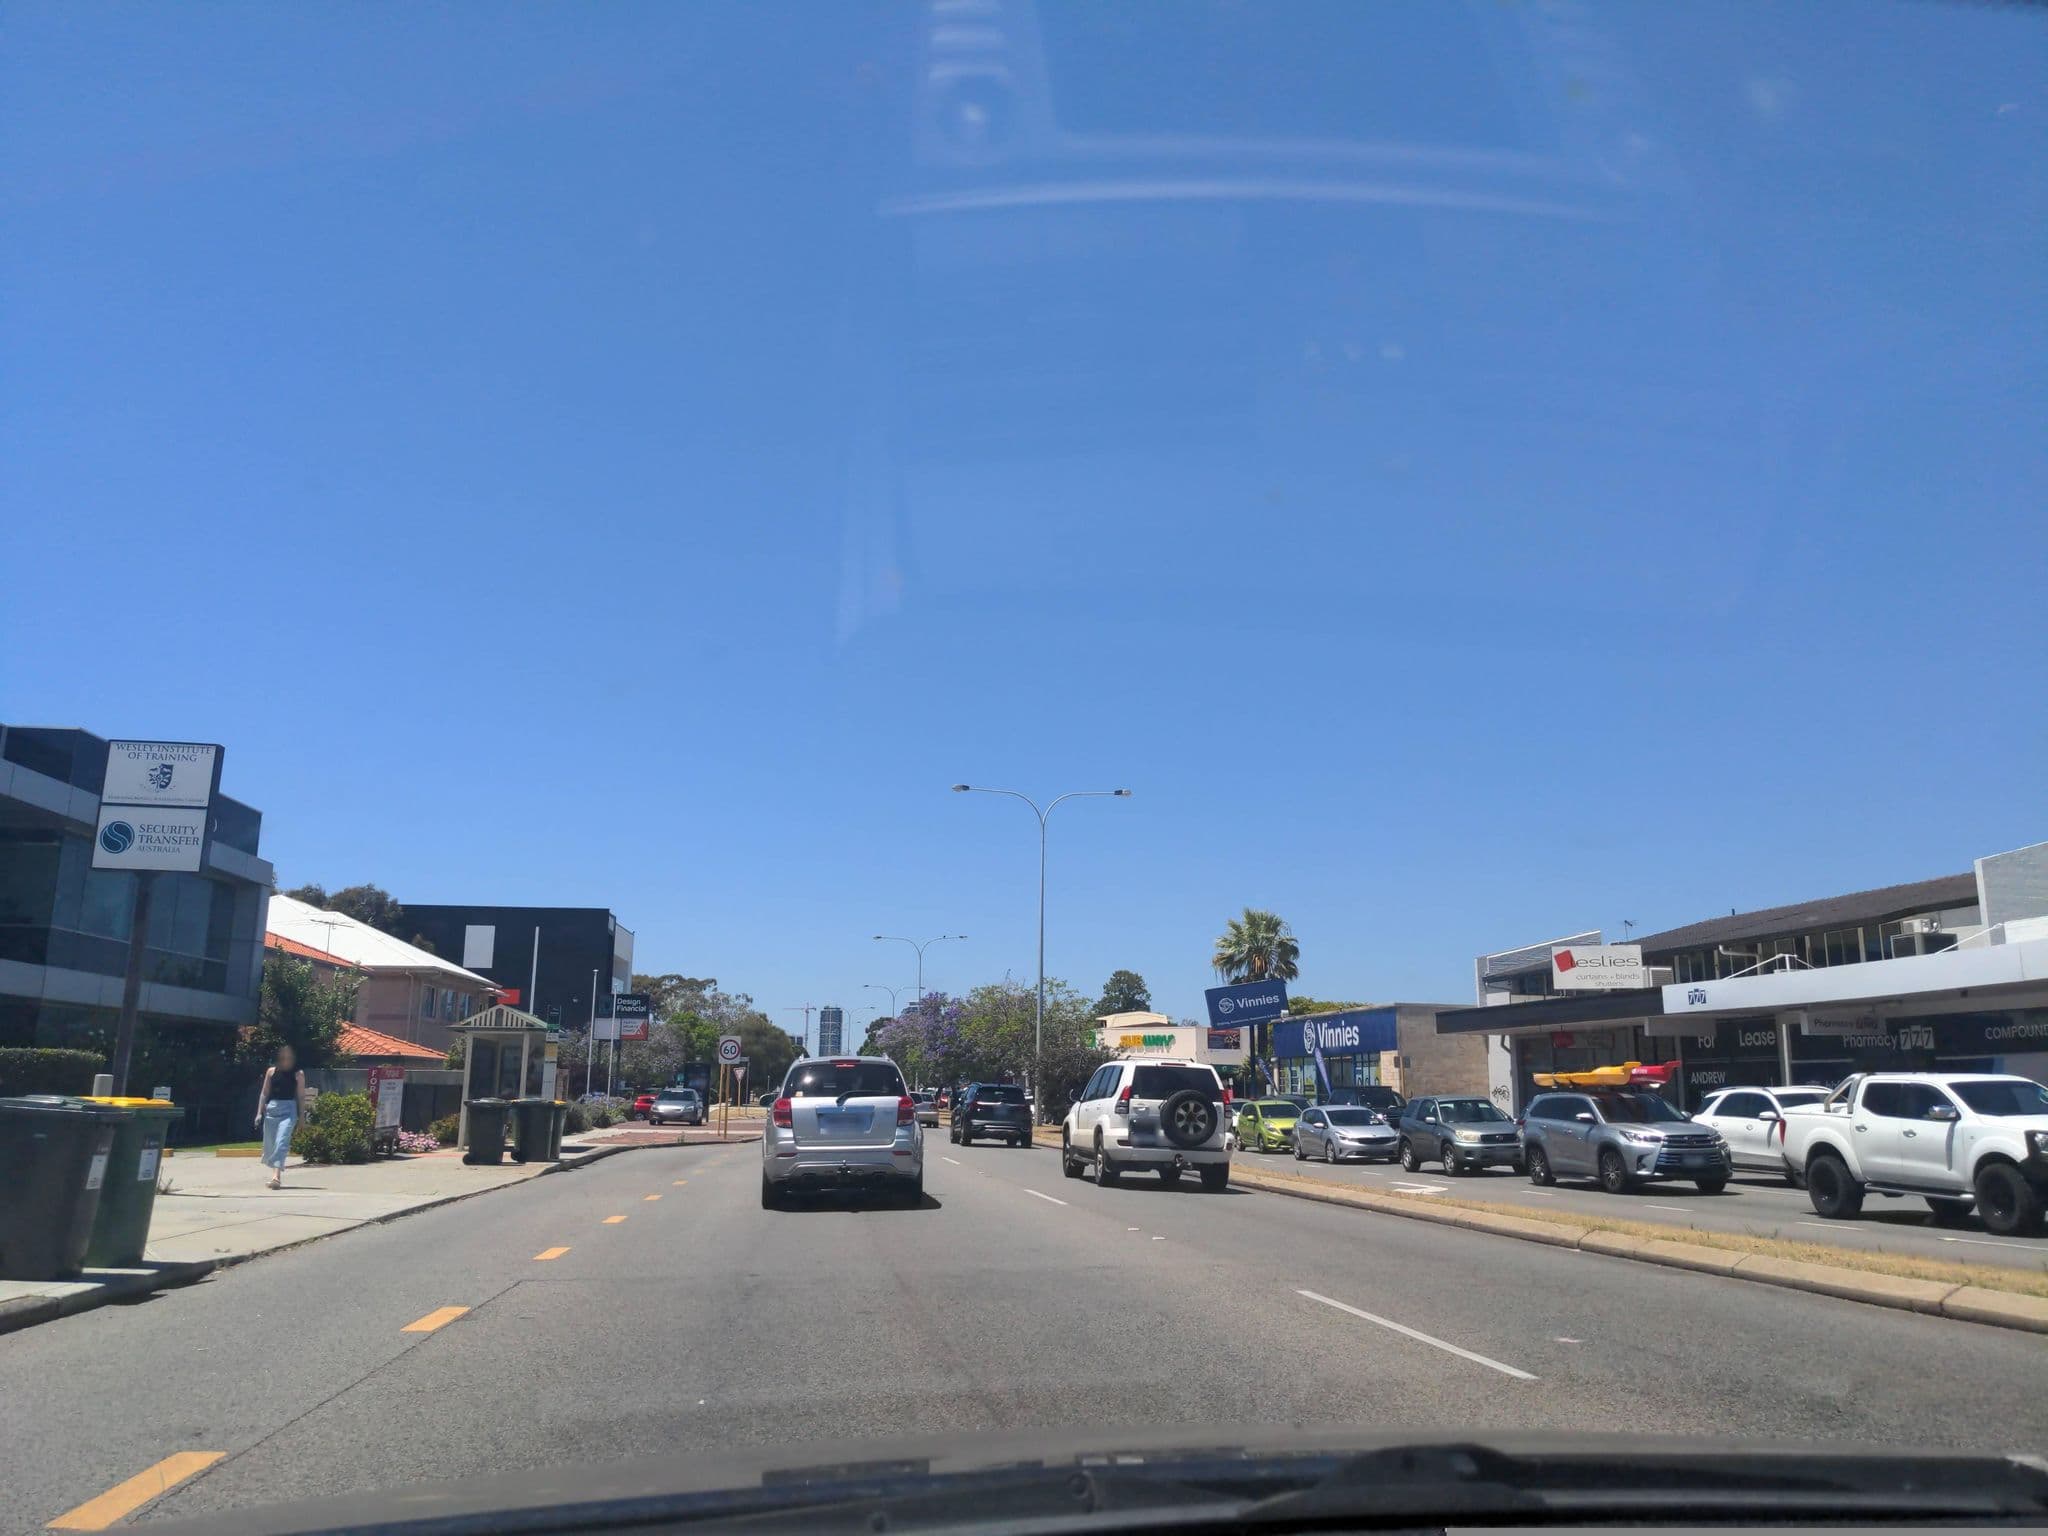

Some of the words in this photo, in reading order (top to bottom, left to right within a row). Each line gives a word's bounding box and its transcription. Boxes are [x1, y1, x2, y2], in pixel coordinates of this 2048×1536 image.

[116, 743, 154, 752] WESLEY
[157, 745, 212, 754] INSTITUTE
[128, 751, 143, 760] OF
[146, 752, 198, 762] TRAINING
[139, 824, 199, 834] SECURITY
[138, 834, 200, 846] TRANSFER
[138, 846, 181, 854] AUSTRALIA
[1616, 972, 1640, 980] blinds
[617, 998, 641, 1006] Design
[1236, 994, 1280, 1009] Vinnies
[616, 1004, 647, 1012] Financial
[1317, 1020, 1360, 1049] Vinnies
[1739, 1029, 1776, 1047] Lease
[1843, 1034, 1898, 1050] Pharmacy
[1900, 1025, 1935, 1050] 777
[723, 1045, 737, 1055] 60
[370, 1069, 378, 1092] FOR
[1690, 1072, 1726, 1084] ANDREW
